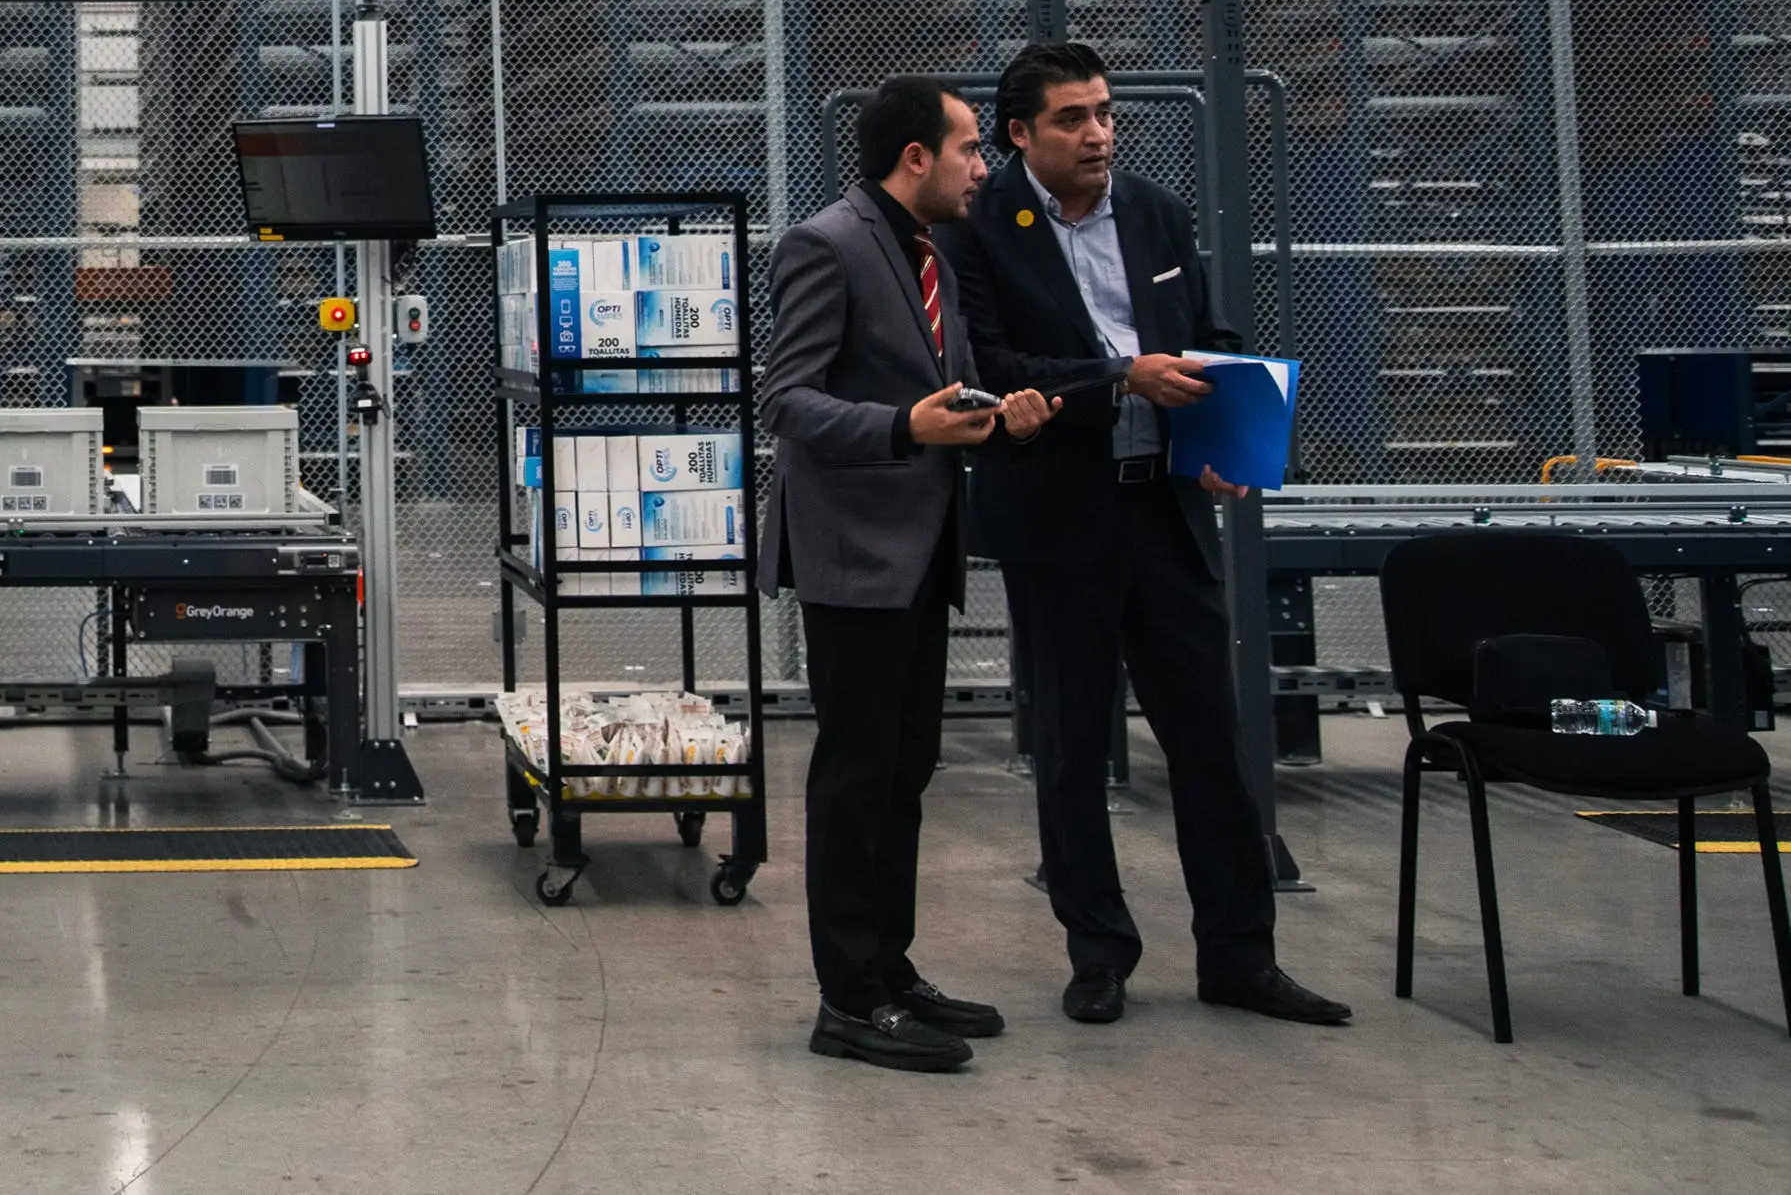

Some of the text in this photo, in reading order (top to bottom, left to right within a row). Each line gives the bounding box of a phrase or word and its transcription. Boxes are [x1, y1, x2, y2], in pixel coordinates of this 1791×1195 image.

[597, 305, 621, 313] OPTI
[682, 297, 690, 339] TOALLITAS
[690, 307, 700, 328] 200
[724, 307, 732, 331] OPTI
[598, 338, 620, 347] 200
[655, 450, 664, 474] OPTI
[688, 452, 698, 474] 200
[698, 441, 706, 484] TOALLITAS
[186, 605, 254, 620] GreyOrange
